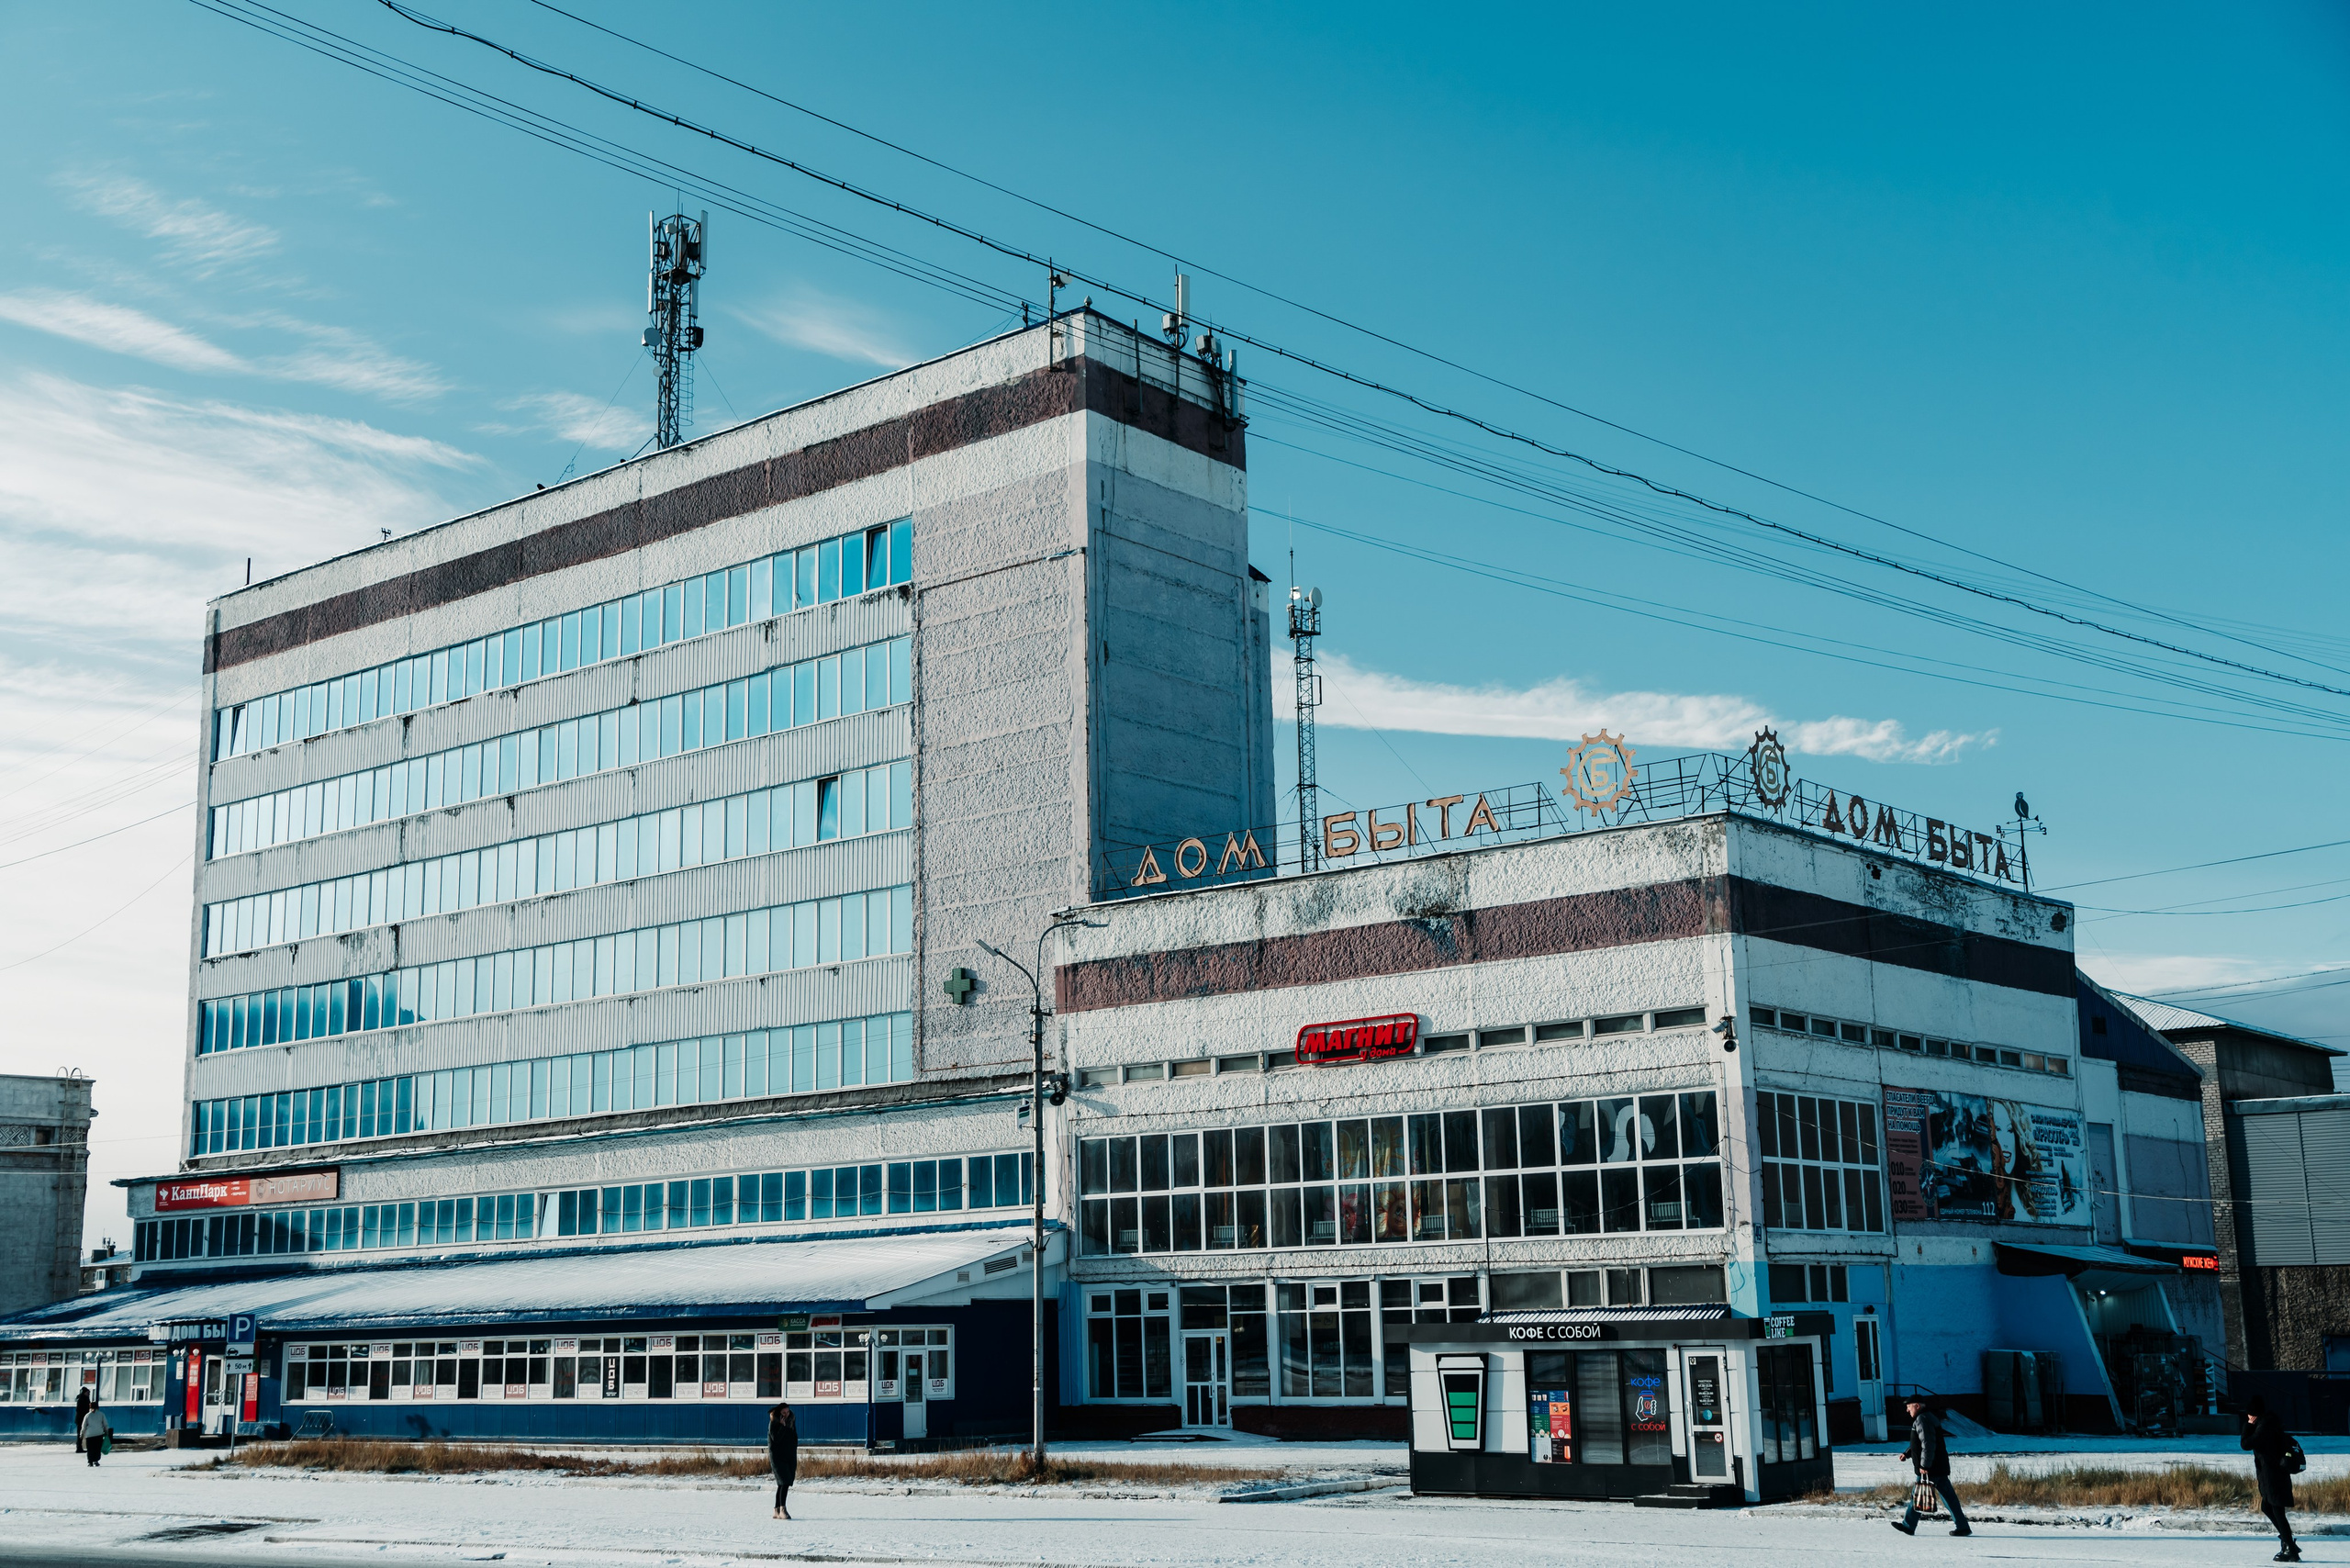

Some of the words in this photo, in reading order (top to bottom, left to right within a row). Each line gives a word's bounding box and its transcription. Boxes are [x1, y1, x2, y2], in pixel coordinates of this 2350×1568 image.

[1131, 829, 1265, 887] ДОМ
[1323, 792, 1500, 857] БЫТА
[1822, 789, 1902, 850] ДОМ
[1927, 818, 2011, 881] БЫТА
[1304, 1022, 1411, 1054] МАГНИТ
[1360, 1050, 1368, 1062] у
[1370, 1047, 1397, 1058] дома
[1886, 1090, 1916, 1104] СПАСАТЕЛИ
[1917, 1092, 1937, 1106] ВСЕГДА
[1886, 1104, 1908, 1119] ПРИДУТ
[1913, 1106, 1925, 1119] ВАМ
[1887, 1118, 1896, 1130] НА
[1896, 1120, 1921, 1134] ПОМОЩЬ
[1891, 1161, 1905, 1176] 010
[171, 1183, 228, 1202] КанцПарк
[269, 1176, 331, 1194] НОТАРИУС
[1893, 1181, 1906, 1194] 020
[1894, 1199, 1908, 1214] 030
[1982, 1202, 1996, 1215] 112
[1770, 1316, 1796, 1327] COFFEE
[172, 1325, 200, 1341] ДОМ
[203, 1324, 226, 1338] БЫ
[1508, 1327, 1544, 1339] КОФЕ
[1547, 1327, 1555, 1338] С
[1558, 1323, 1601, 1338] СОБОЙ
[1770, 1327, 1785, 1338] LIKE
[1630, 1374, 1661, 1389] кофе
[1630, 1423, 1636, 1431] с
[1639, 1421, 1666, 1431] собой
